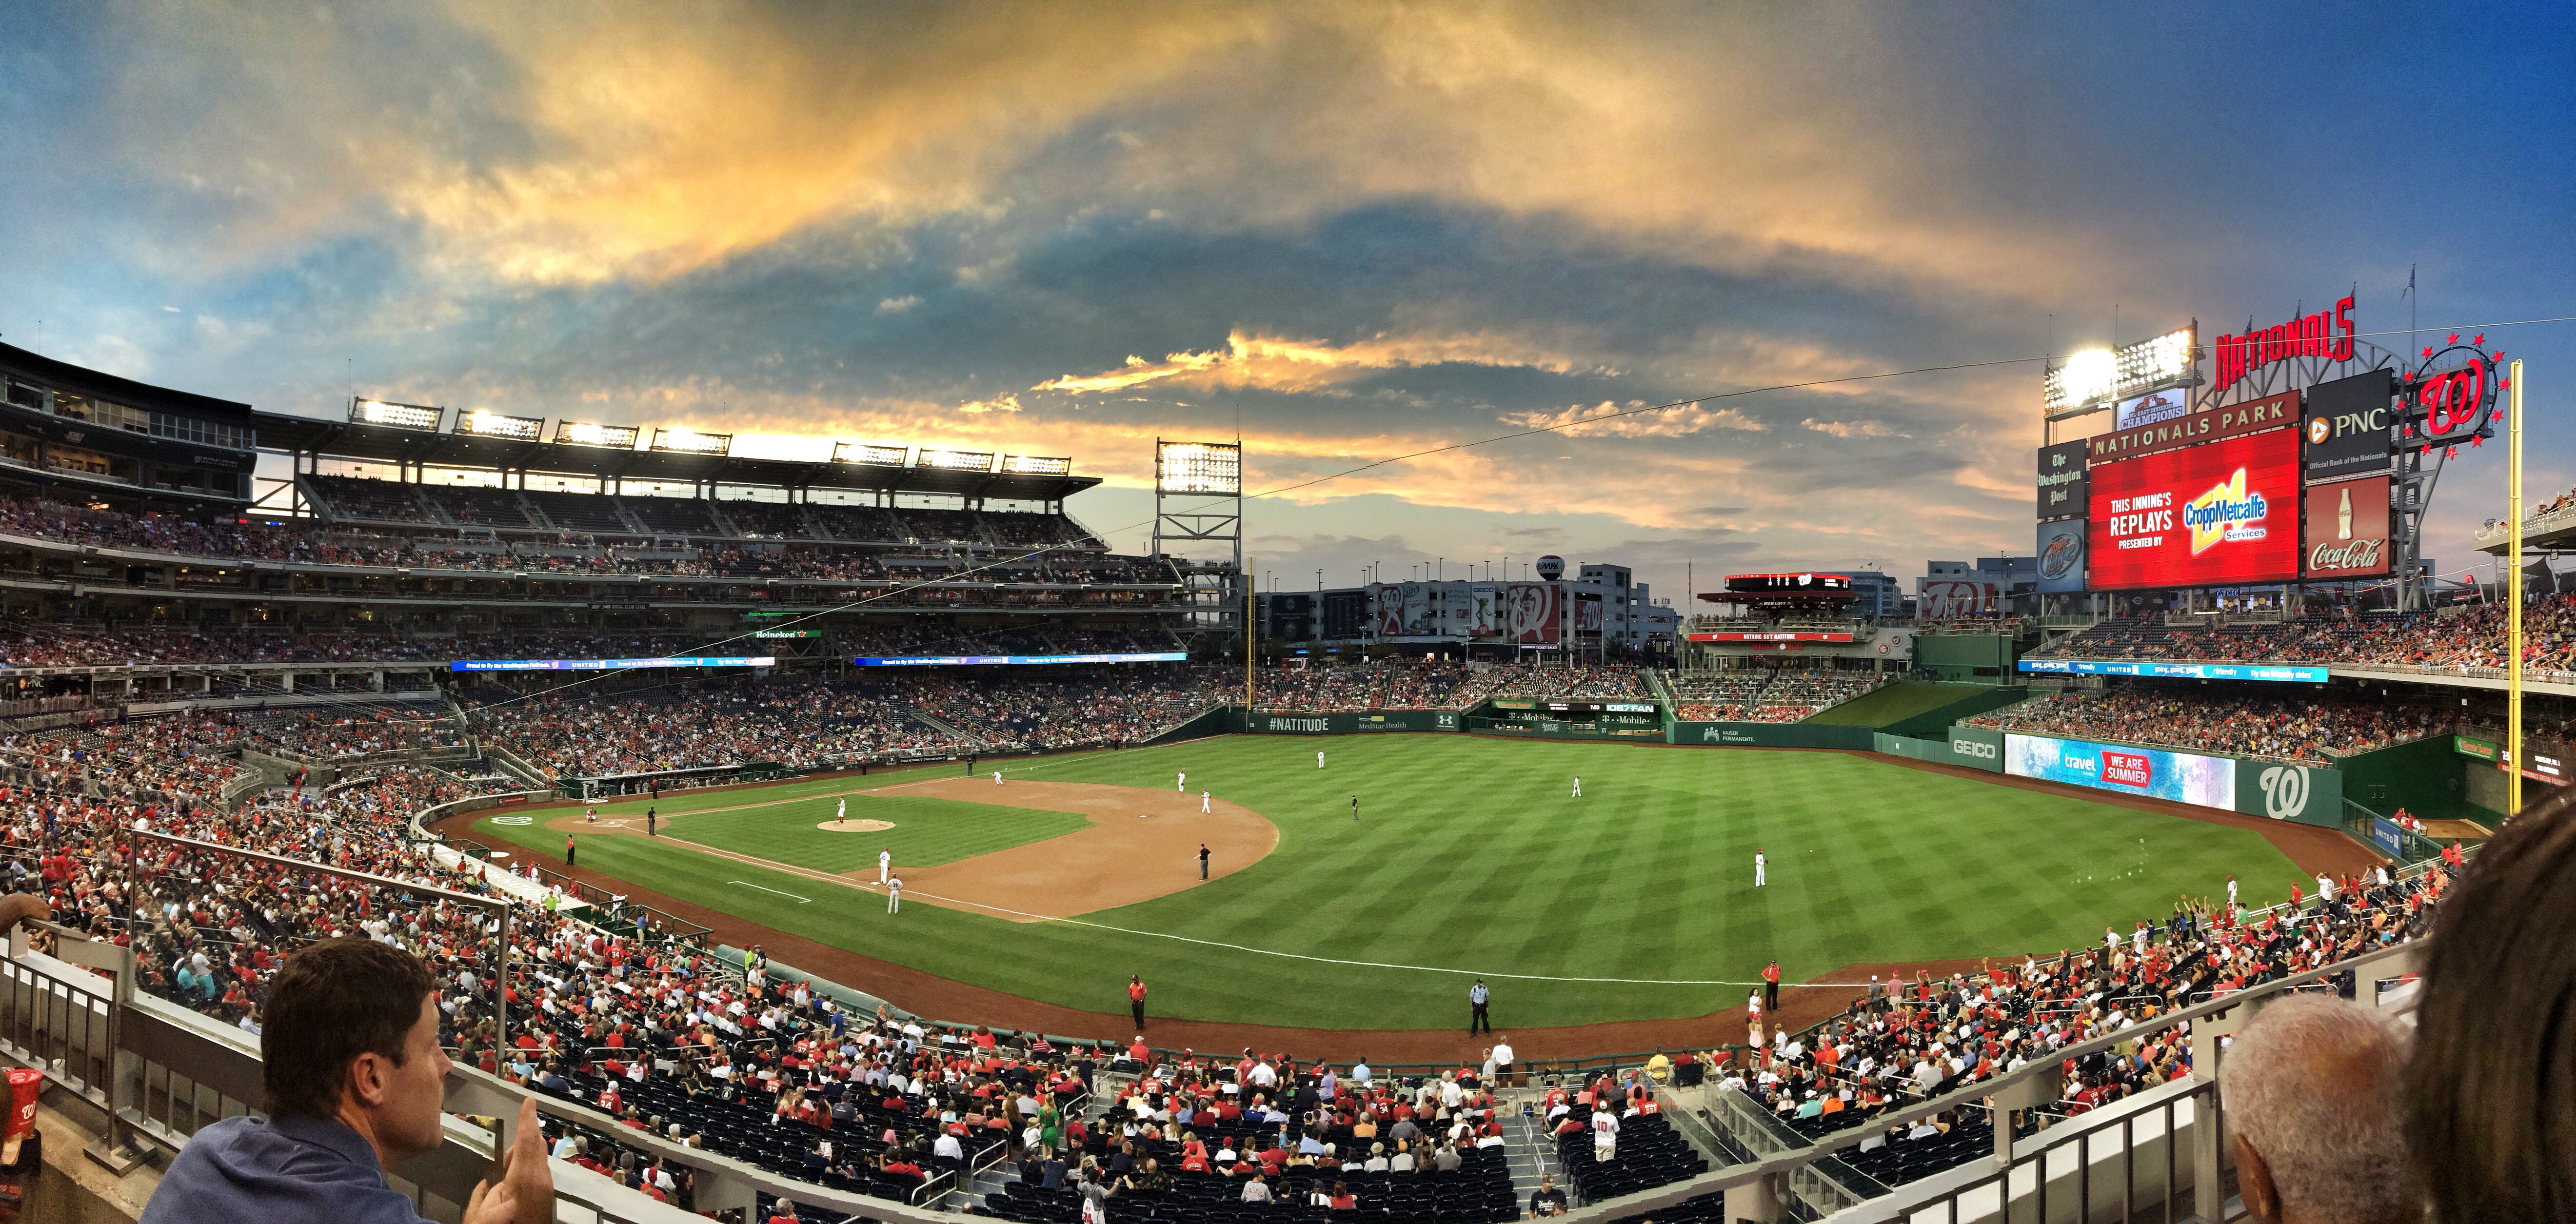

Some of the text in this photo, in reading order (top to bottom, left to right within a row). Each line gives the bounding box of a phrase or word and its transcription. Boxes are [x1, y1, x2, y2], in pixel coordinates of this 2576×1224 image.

[2216, 296, 2355, 392] NATIONALS
[2420, 357, 2484, 435] W
[2150, 403, 2172, 414] DIVISION
[2121, 408, 2183, 430] CHAMPIONS
[2334, 408, 2386, 437] PNC
[2095, 401, 2283, 455] NATIONALS PARK
[2052, 453, 2066, 468] The
[2310, 461, 2328, 469] Official
[2360, 452, 2387, 461] Nationals
[2038, 470, 2081, 487] Washington
[2050, 489, 2068, 506] Post
[2111, 492, 2171, 513] THIS INNING'S
[2185, 494, 2265, 531] CroppMetcalfe
[2110, 510, 2172, 536] REPLAYS
[2119, 536, 2162, 550] PRESENTED BY
[2226, 530, 2265, 539] Services
[2310, 538, 2382, 571] Coca-Cola
[2270, 671, 2294, 679] friendly
[1269, 718, 1328, 731] #NATITUDE
[1954, 739, 1995, 759] GEICO
[2065, 752, 2096, 771] travel
[2111, 755, 2142, 770] WE ARE
[2108, 767, 2147, 784] SUMMER
[2376, 828, 2393, 843] UNITED
[600, 1100, 612, 1109] 34
[602, 1092, 614, 1101] HARPER
[1597, 1120, 1607, 1132] 10
